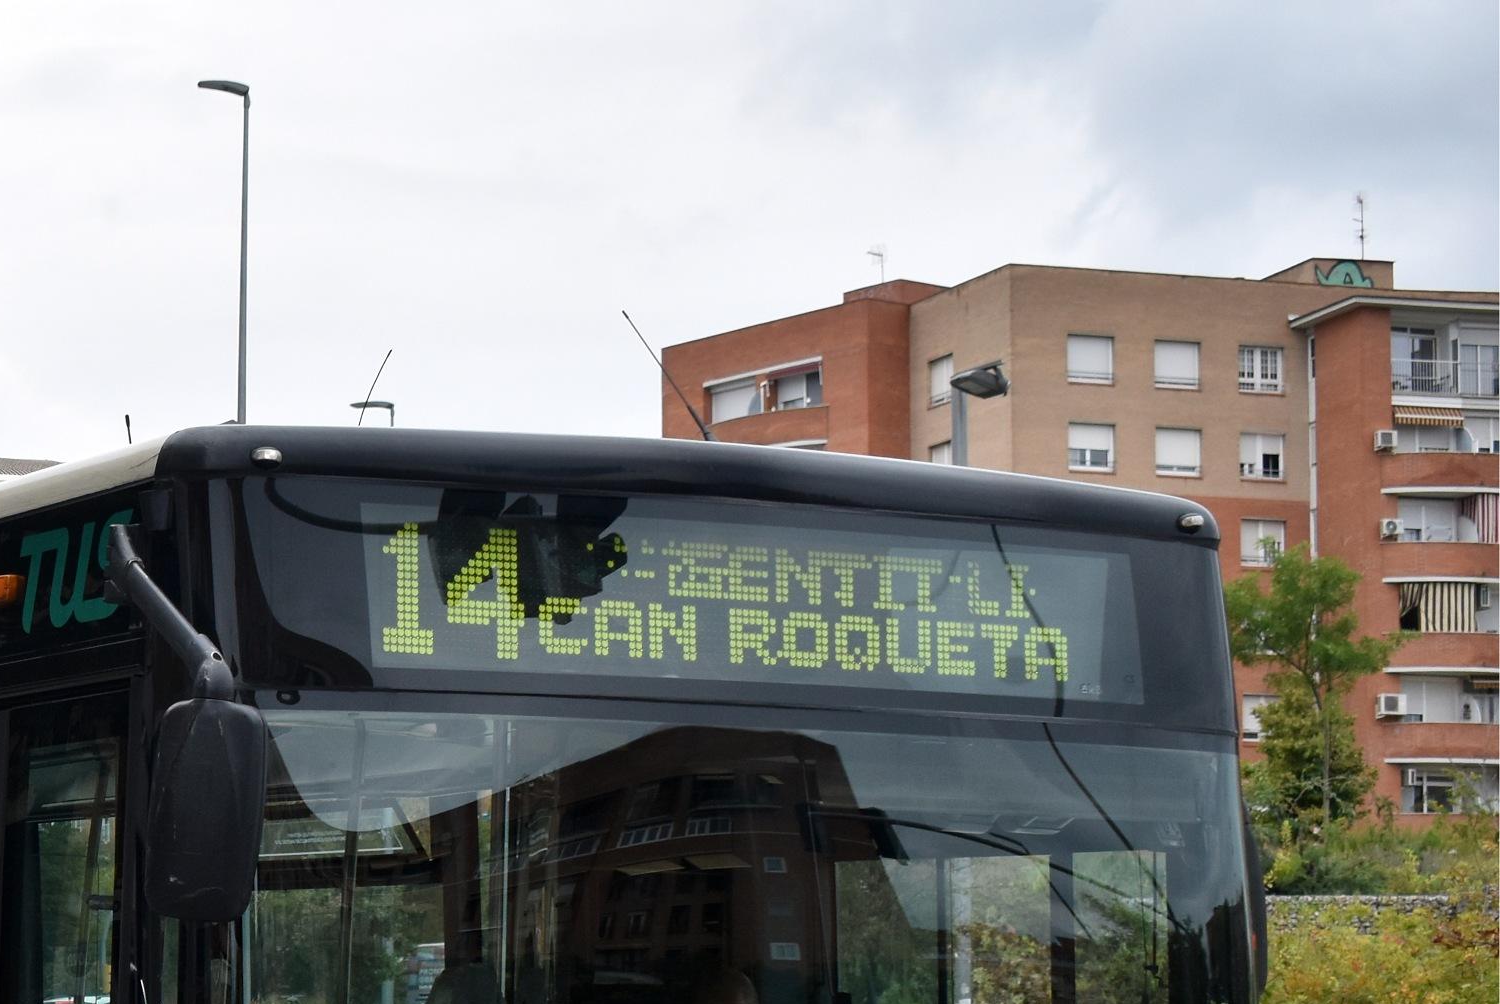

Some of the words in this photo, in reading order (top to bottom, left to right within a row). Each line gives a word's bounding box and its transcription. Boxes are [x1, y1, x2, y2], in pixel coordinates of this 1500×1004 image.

[382, 522, 525, 660] 14
[539, 596, 698, 662] CAN
[728, 607, 1069, 682] ROQUETA
